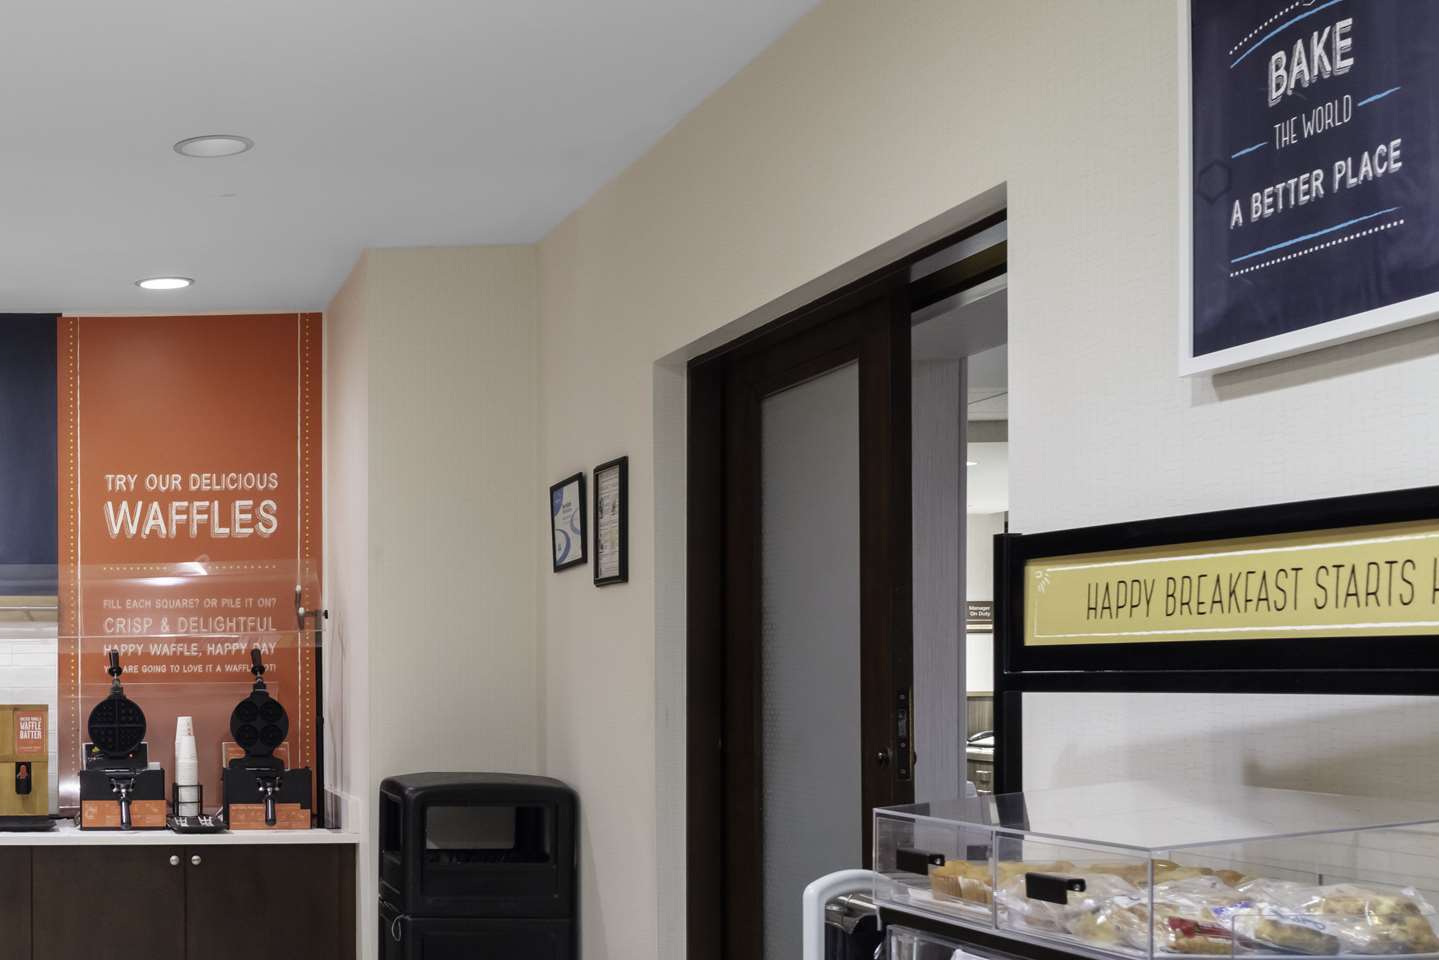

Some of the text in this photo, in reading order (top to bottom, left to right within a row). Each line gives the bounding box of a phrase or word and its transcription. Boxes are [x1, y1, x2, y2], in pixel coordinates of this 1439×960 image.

[1268, 18, 1354, 107] BAKE
[1273, 95, 1352, 150] THE WORLD
[1230, 138, 1402, 230] A BETTER PLACE
[105, 472, 279, 492] TRY OUR DELICIOUS
[104, 500, 279, 539] WAFFLES
[1086, 577, 1156, 620] HAPPY
[1164, 567, 1304, 617] BREAKFAST
[1313, 558, 1416, 611] STARTS
[103, 598, 277, 609] FILL EACH SQUARE? OR PILE IT ON?
[104, 615, 277, 633] CRISP & DELIGHTFUL
[150, 643, 203, 656] WAFFLE,
[207, 642, 248, 655] HAPPY
[123, 665, 139, 673] ARE
[142, 665, 167, 673] GOING
[170, 665, 180, 673] TO
[182, 664, 203, 673] LOVE
[206, 664, 213, 672] IT
[216, 664, 222, 672] A
[224, 664, 253, 672] WAFFL
[19, 721, 41, 730] WAFFLE
[19, 730, 41, 739] BATTER
